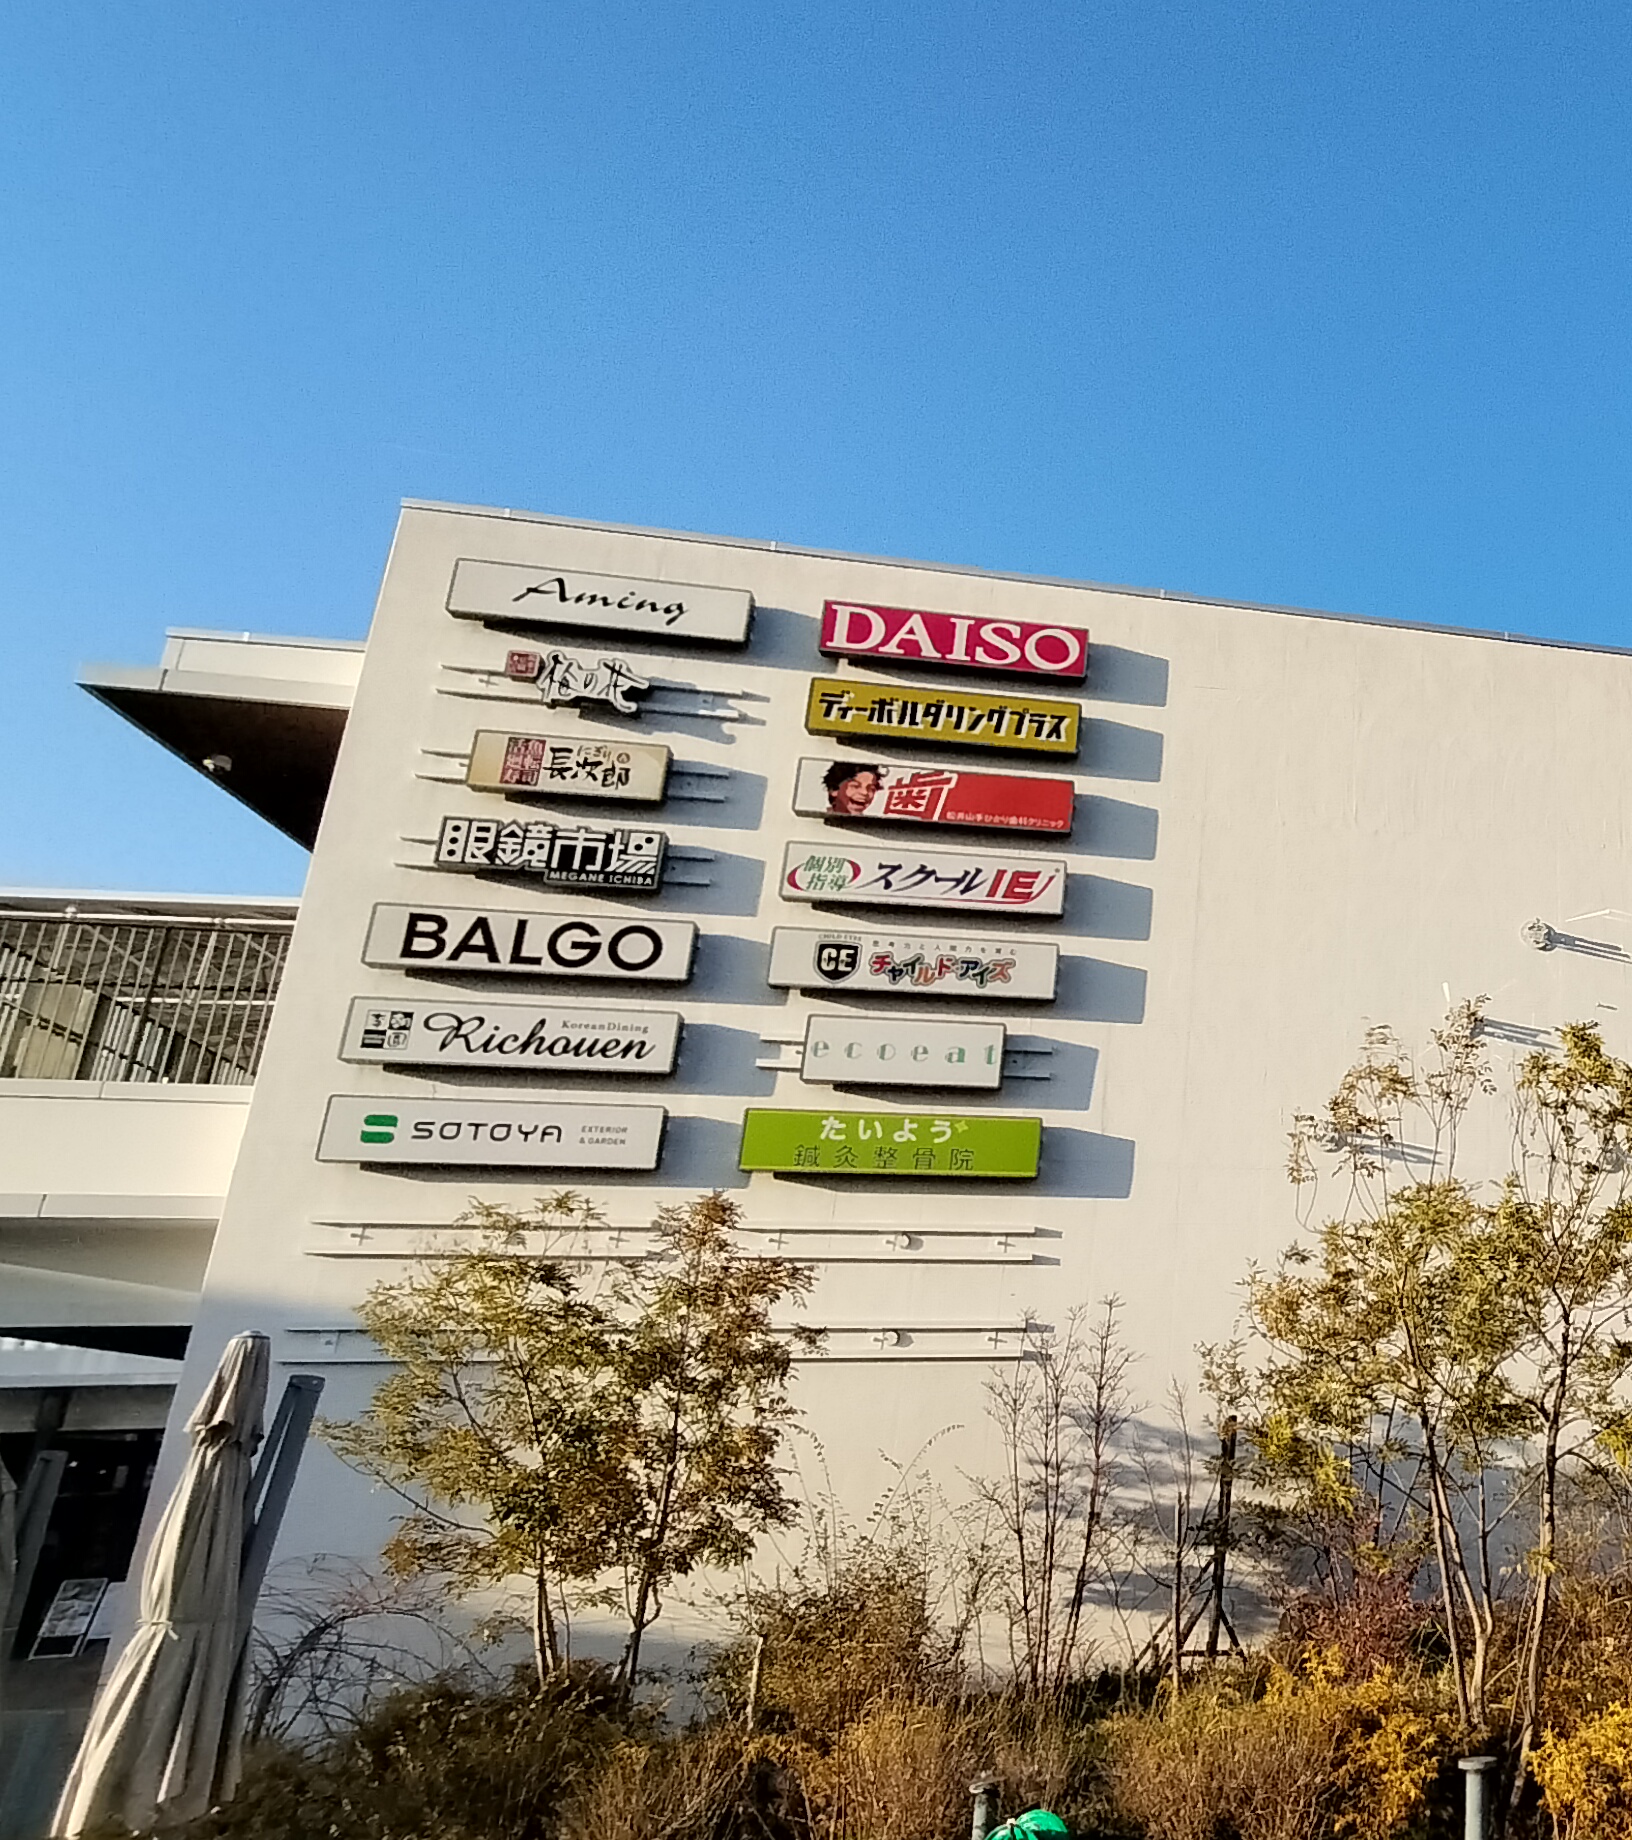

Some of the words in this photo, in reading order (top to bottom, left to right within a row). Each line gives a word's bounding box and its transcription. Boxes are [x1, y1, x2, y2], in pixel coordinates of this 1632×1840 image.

[512, 577, 689, 625] Aming
[825, 604, 1081, 671] DAISO
[819, 689, 1069, 741] ディーボルダリングプラス
[543, 746, 631, 790] 長次郎
[883, 770, 958, 821] 歯
[438, 819, 661, 875] 眼鏡市場
[803, 855, 847, 873] 個別
[549, 871, 604, 883] MEGANE
[609, 876, 653, 886] ICHIBA
[805, 872, 849, 892] 指導
[399, 912, 664, 971] BALGO
[820, 947, 855, 972] CE
[423, 1012, 657, 1060] Richouen
[411, 1121, 563, 1143] SOTOYA
[819, 1115, 953, 1144] たいよう
[792, 1143, 975, 1171] 鍼灸整骨院
